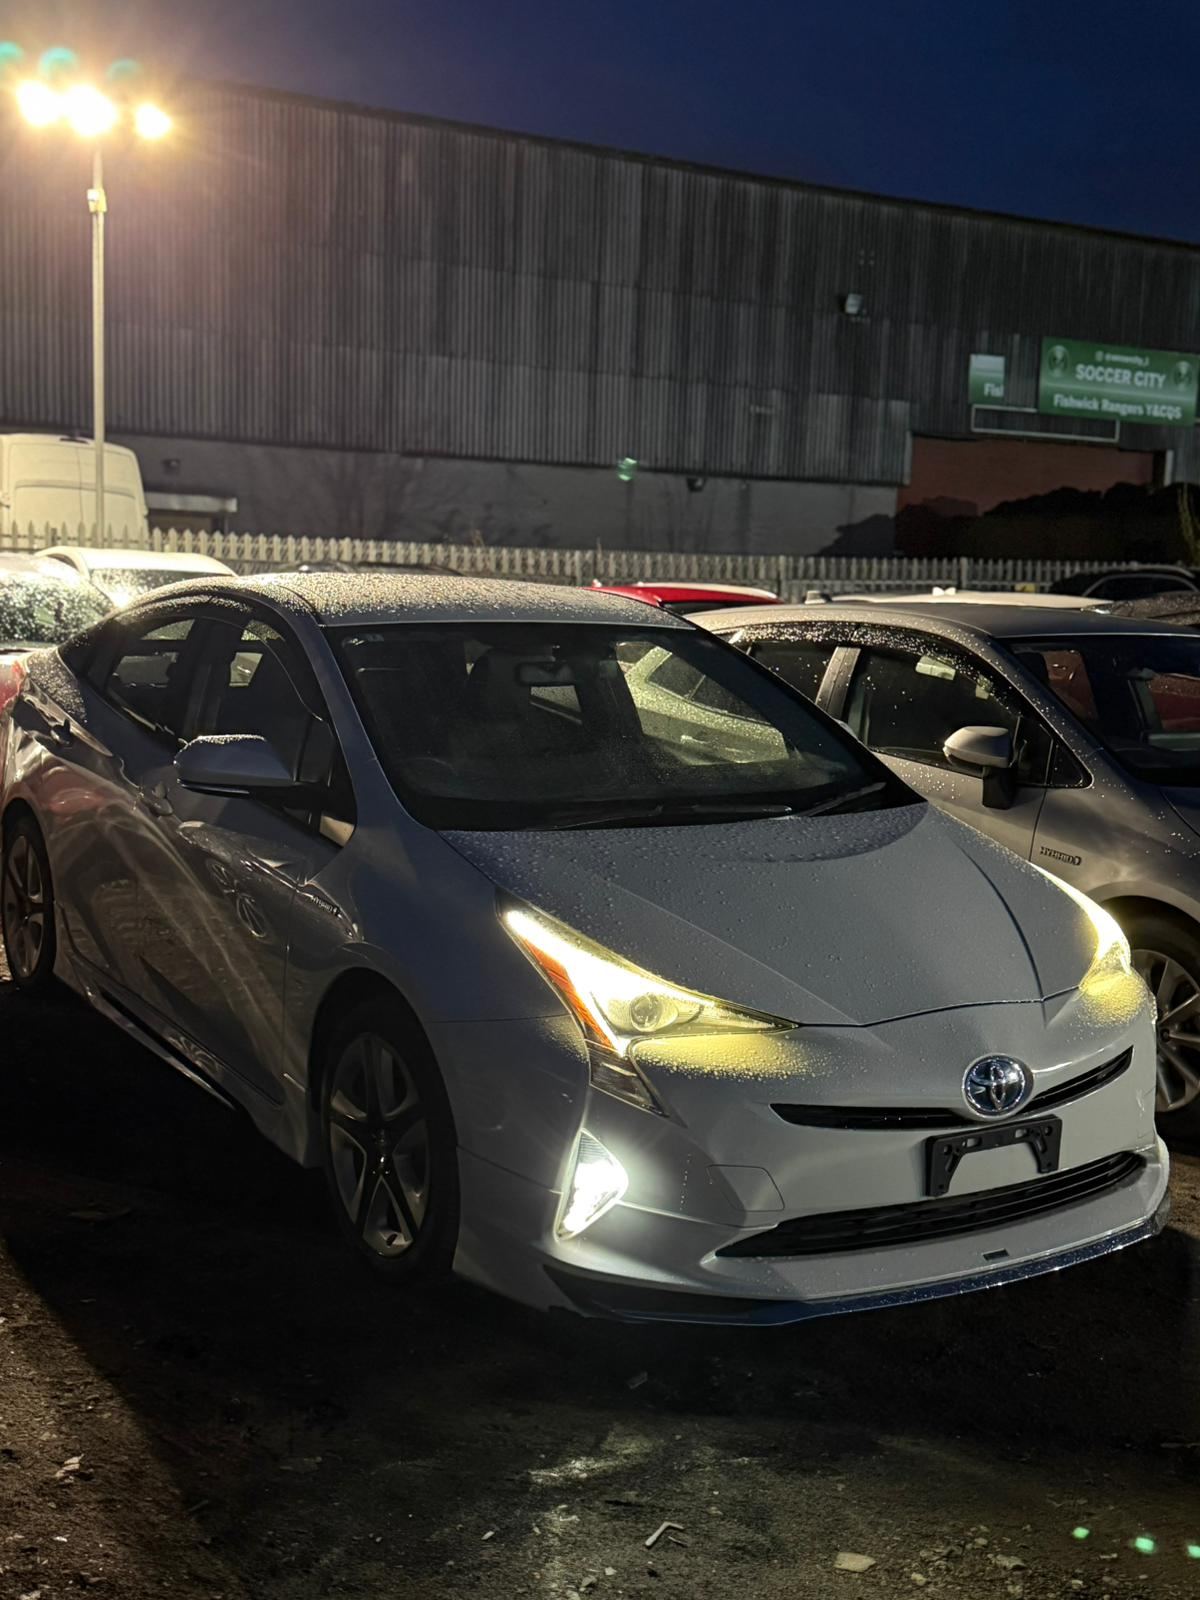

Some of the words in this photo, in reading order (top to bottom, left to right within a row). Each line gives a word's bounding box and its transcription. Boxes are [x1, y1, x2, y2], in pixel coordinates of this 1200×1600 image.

[1075, 363, 1131, 385] SOCCER
[1134, 371, 1166, 388] CITY
[1053, 394, 1099, 411] Fishwick
[1101, 399, 1144, 416] Rangers
